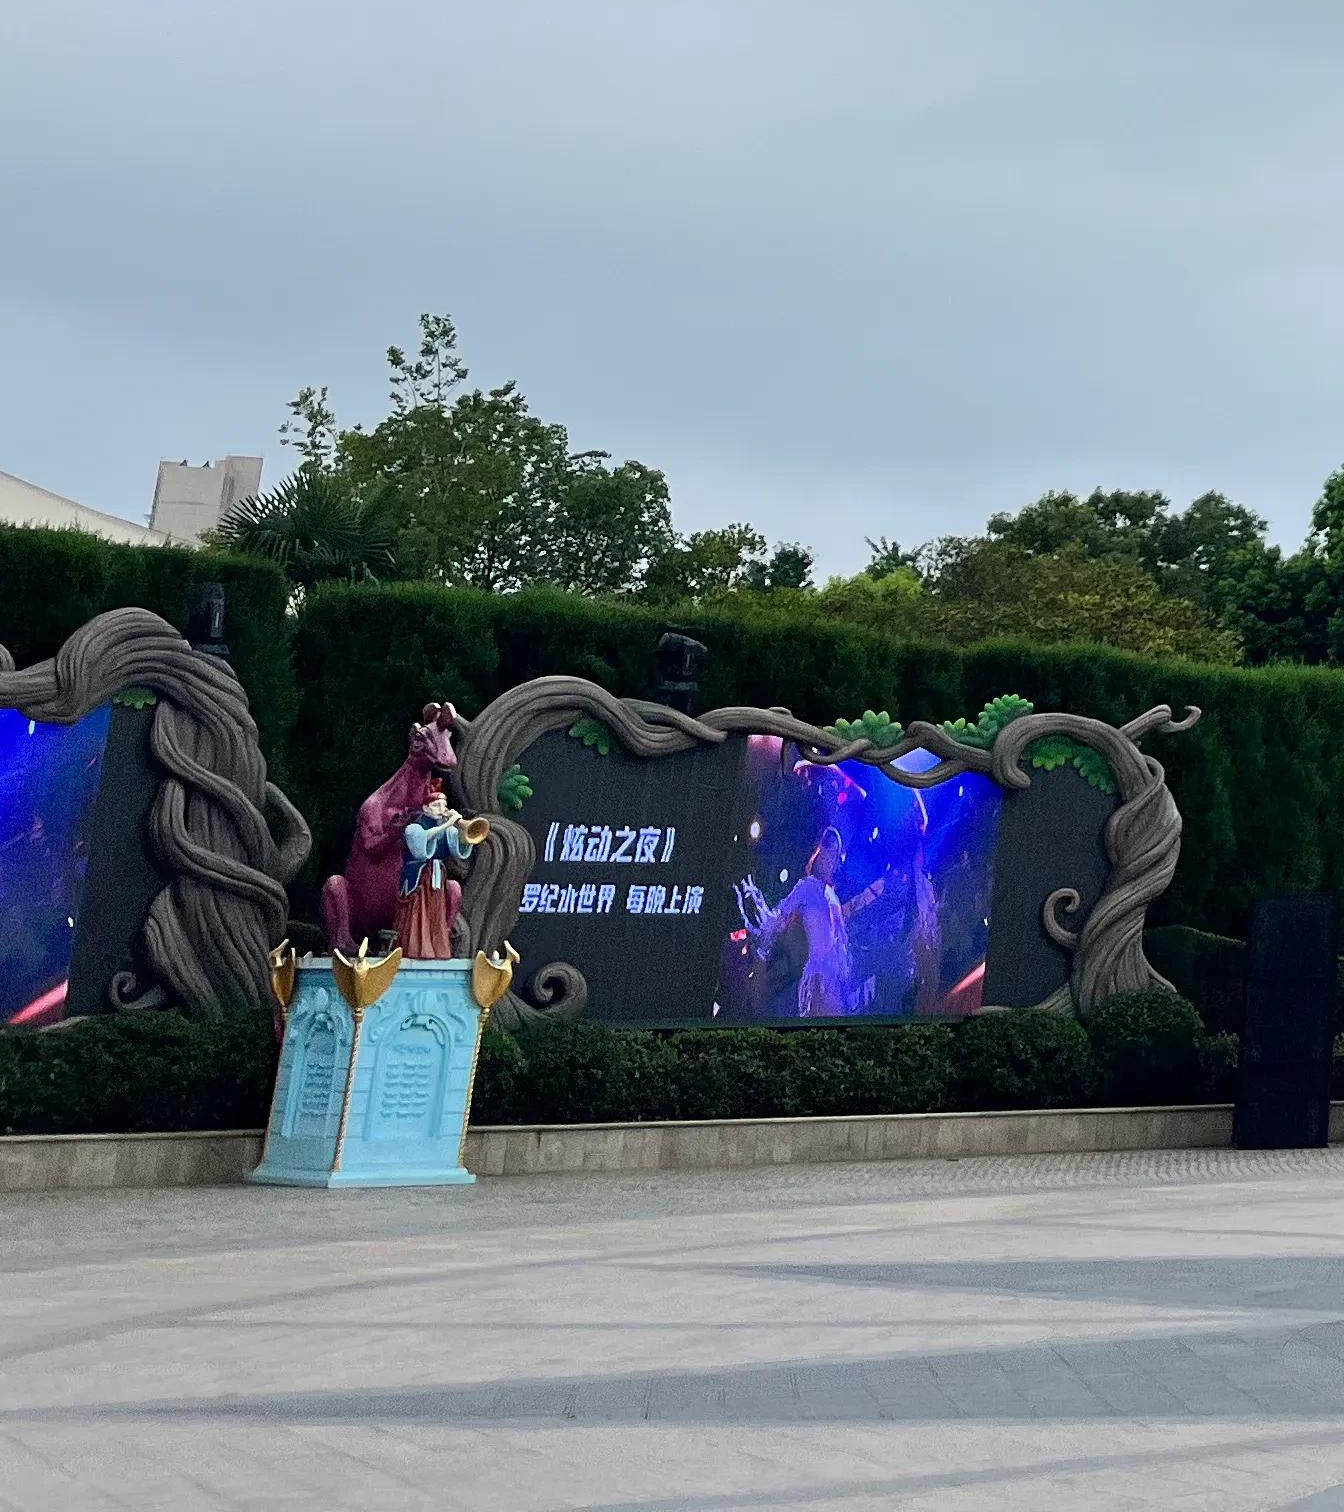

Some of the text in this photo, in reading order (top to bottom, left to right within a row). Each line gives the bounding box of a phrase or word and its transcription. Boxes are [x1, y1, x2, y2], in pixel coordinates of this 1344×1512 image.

[519, 883, 705, 914] 罗纪水世界 每晚上演
